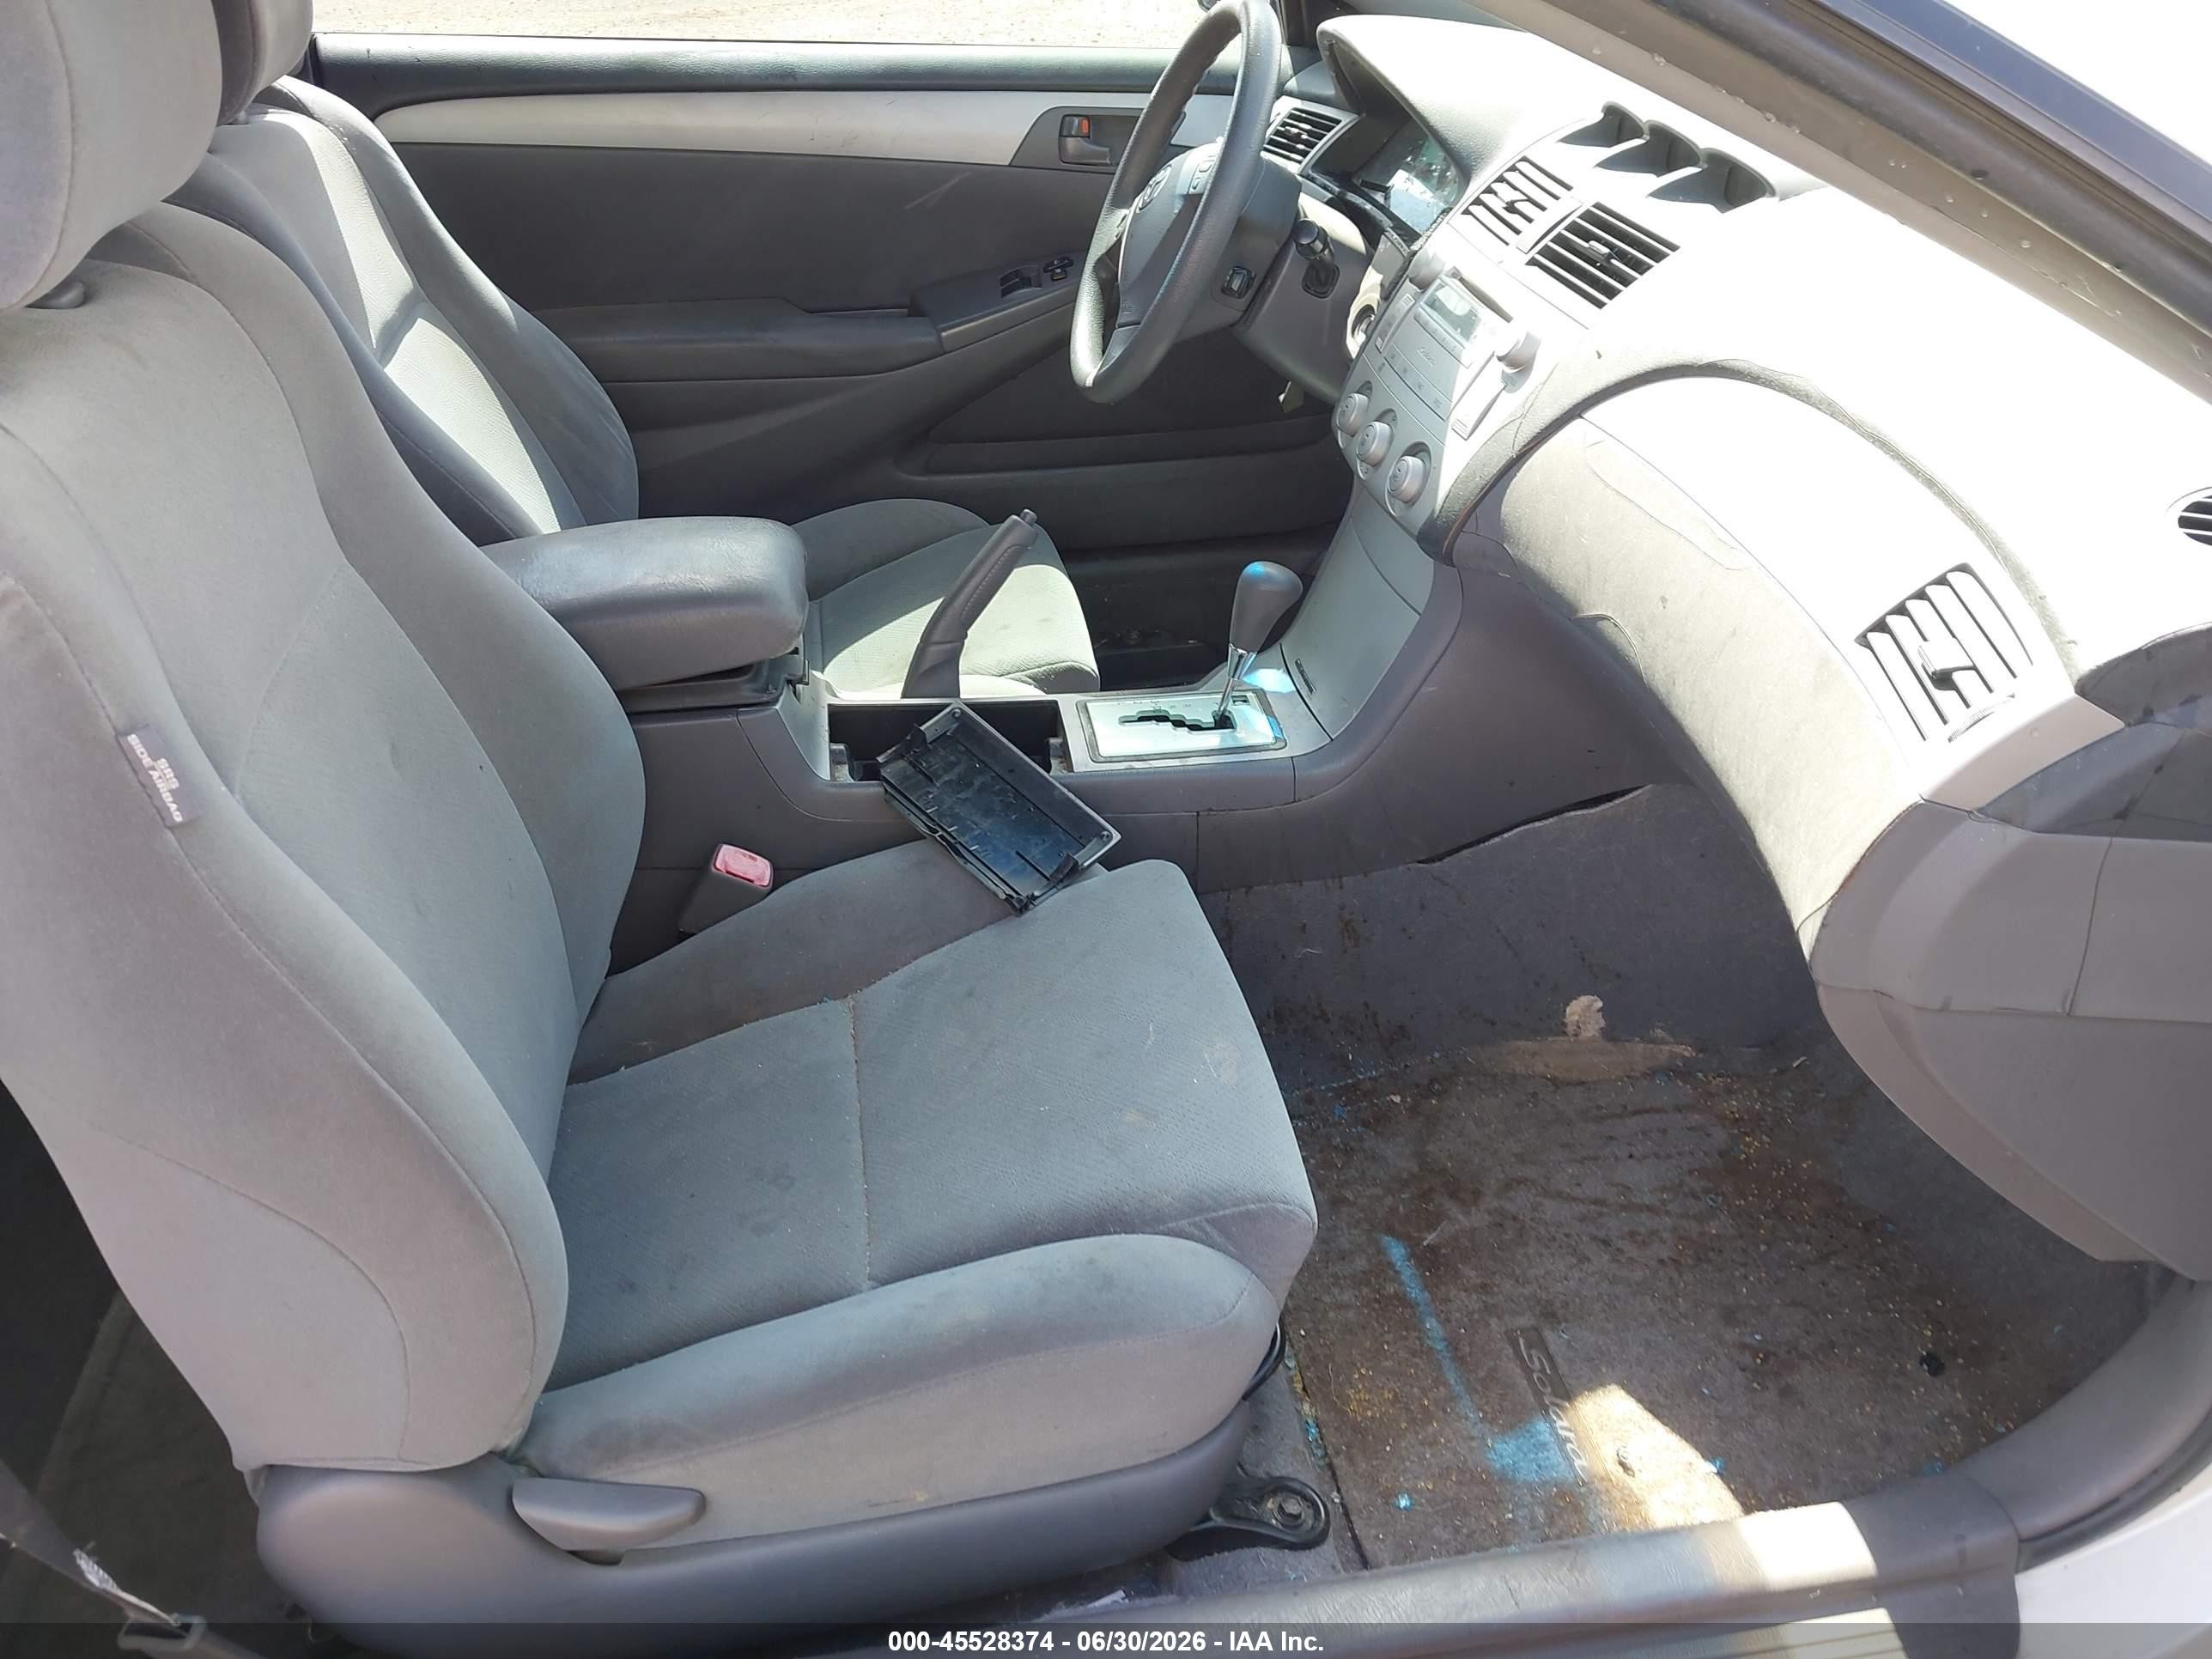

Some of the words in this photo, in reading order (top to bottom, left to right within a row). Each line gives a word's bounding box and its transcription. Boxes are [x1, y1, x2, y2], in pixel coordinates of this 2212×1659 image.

[127, 733, 154, 769] SIDE
[148, 769, 183, 823] AIRBAG
[156, 758, 179, 789] SRS
[1518, 1336, 1589, 1484] Solara
